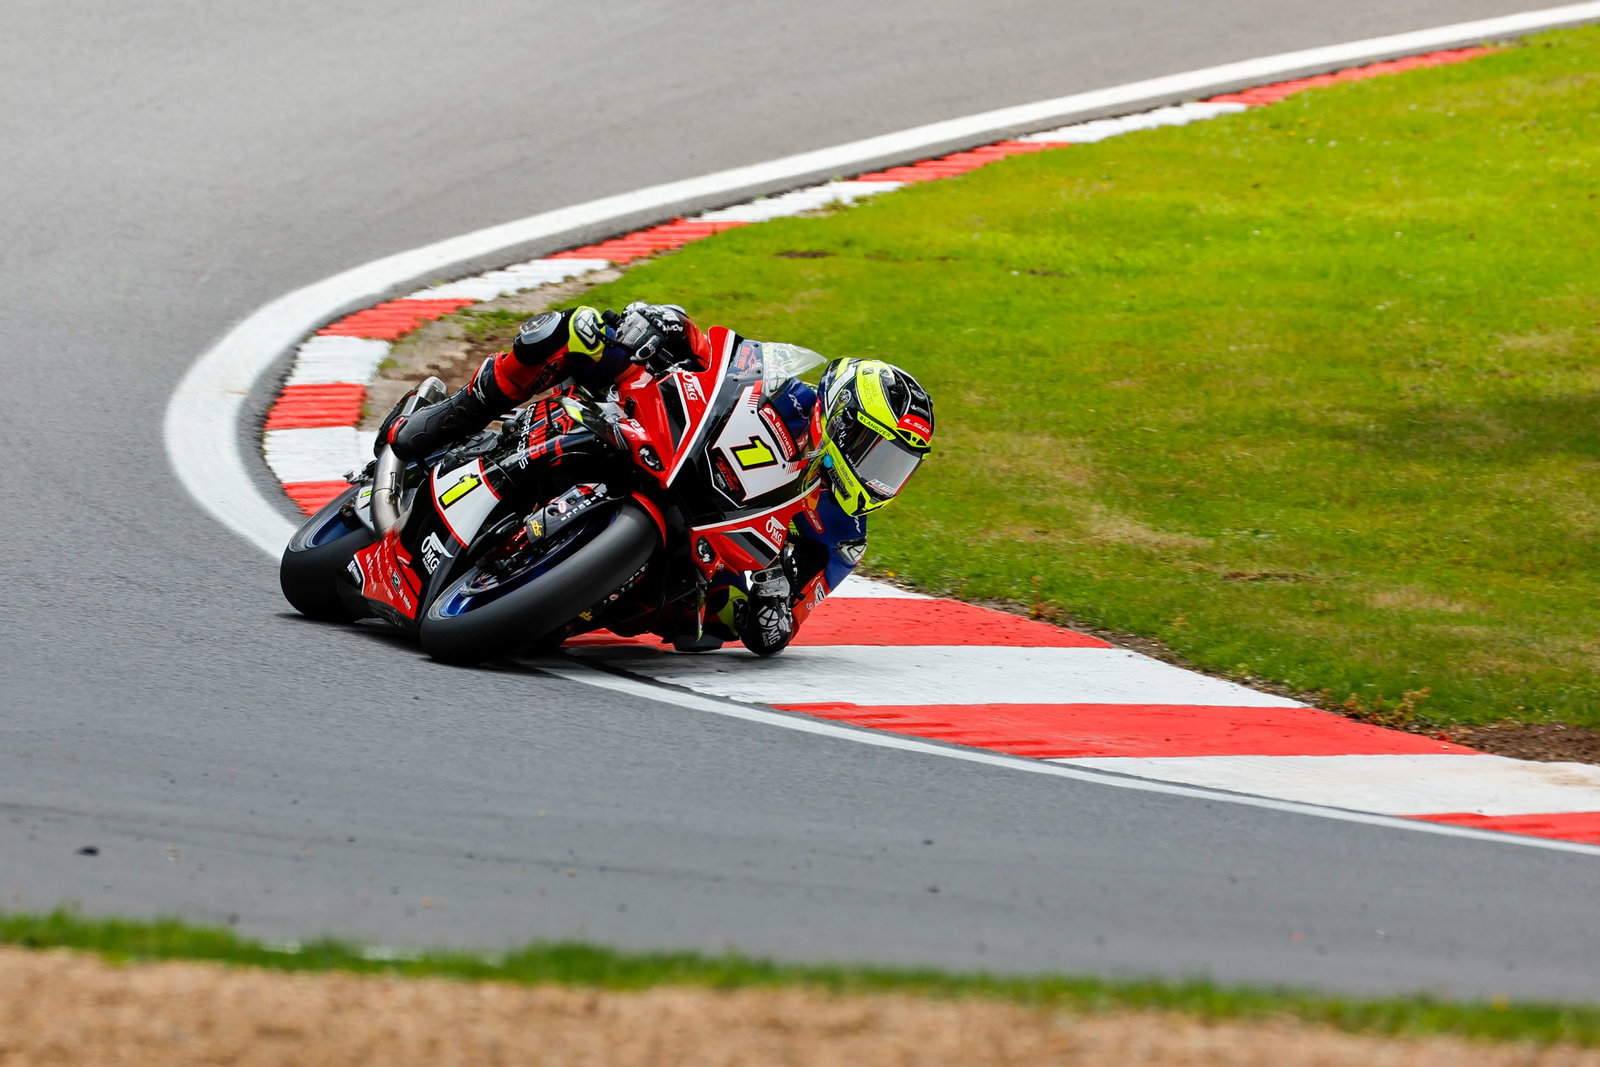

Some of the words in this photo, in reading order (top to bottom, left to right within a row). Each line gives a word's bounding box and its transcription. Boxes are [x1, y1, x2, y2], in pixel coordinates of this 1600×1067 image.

[731, 436, 777, 470] 1
[775, 421, 794, 457] Bennetts
[438, 474, 481, 509] 1
[560, 491, 604, 522] PIRELLI
[766, 519, 783, 541] OMG
[421, 535, 441, 572] OMG
